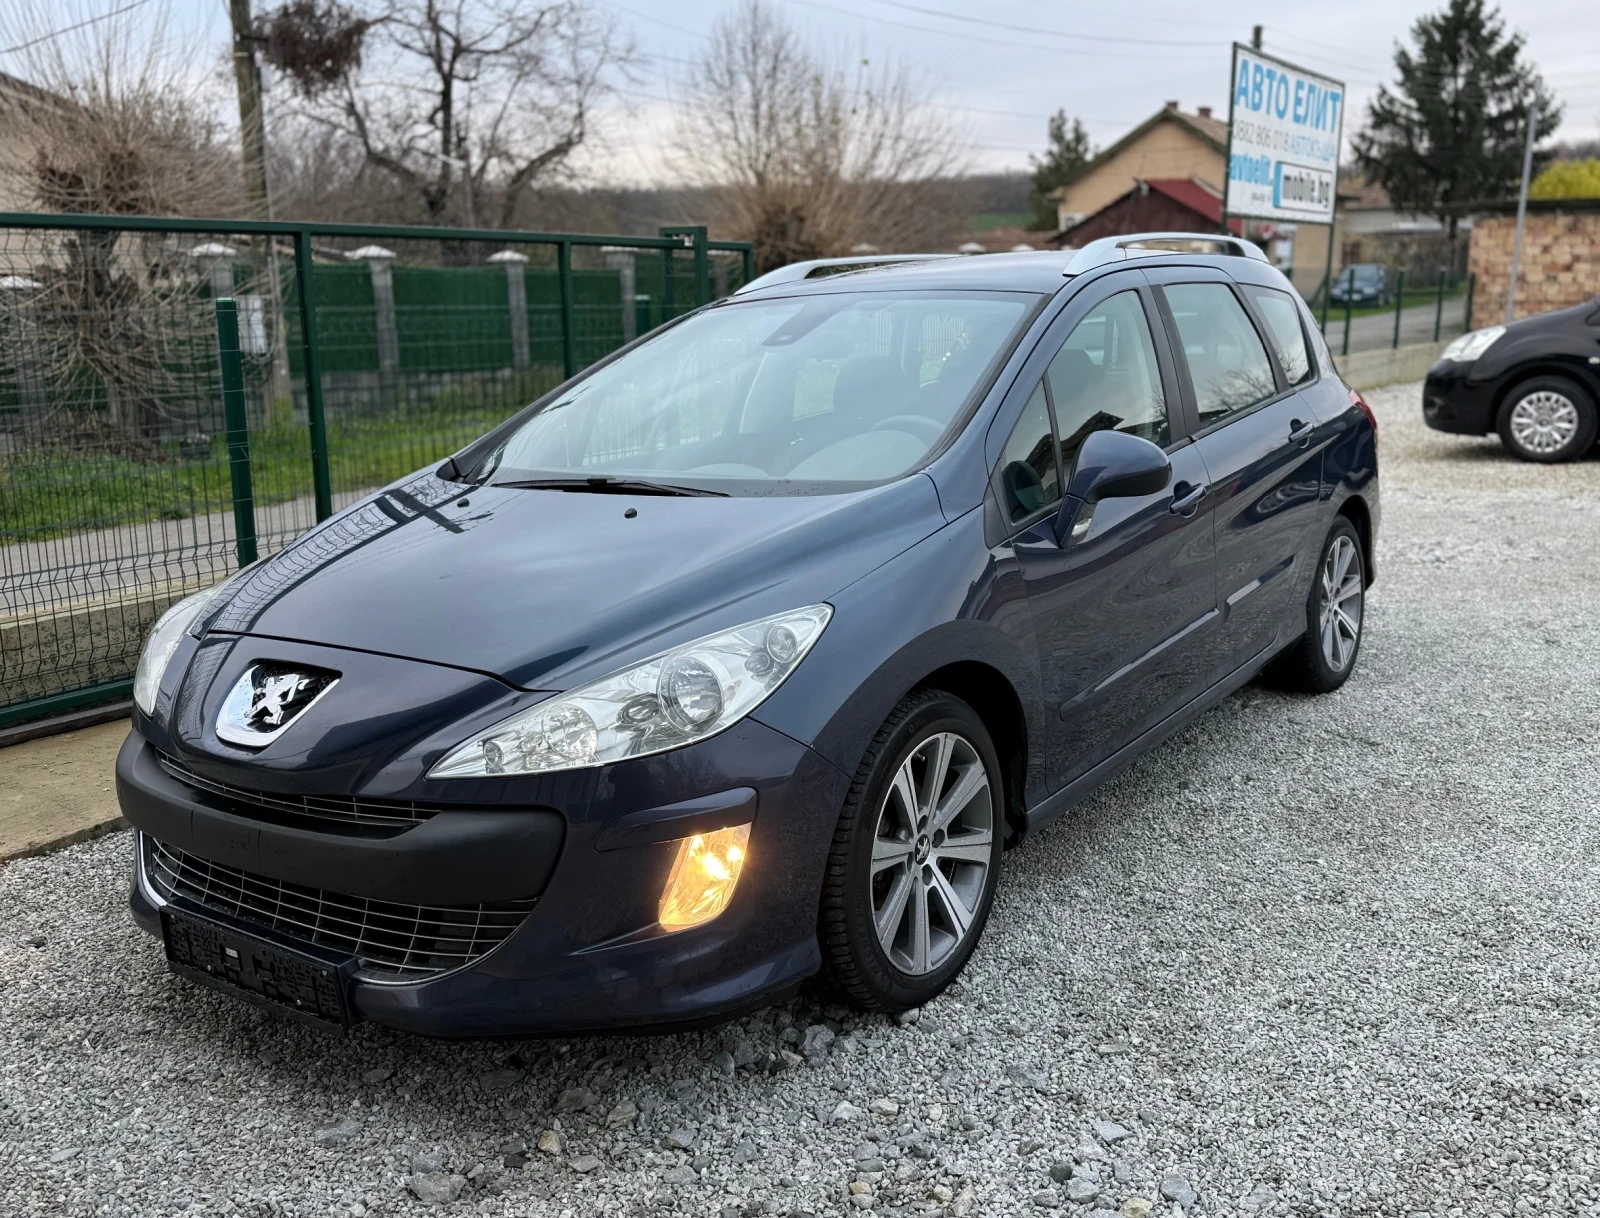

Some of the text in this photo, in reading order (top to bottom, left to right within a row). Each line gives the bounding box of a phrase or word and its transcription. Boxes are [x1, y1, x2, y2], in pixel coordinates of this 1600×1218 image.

[1233, 58, 1341, 133] АВТО ЕЛИТ
[1282, 171, 1330, 209] mobile.bg
